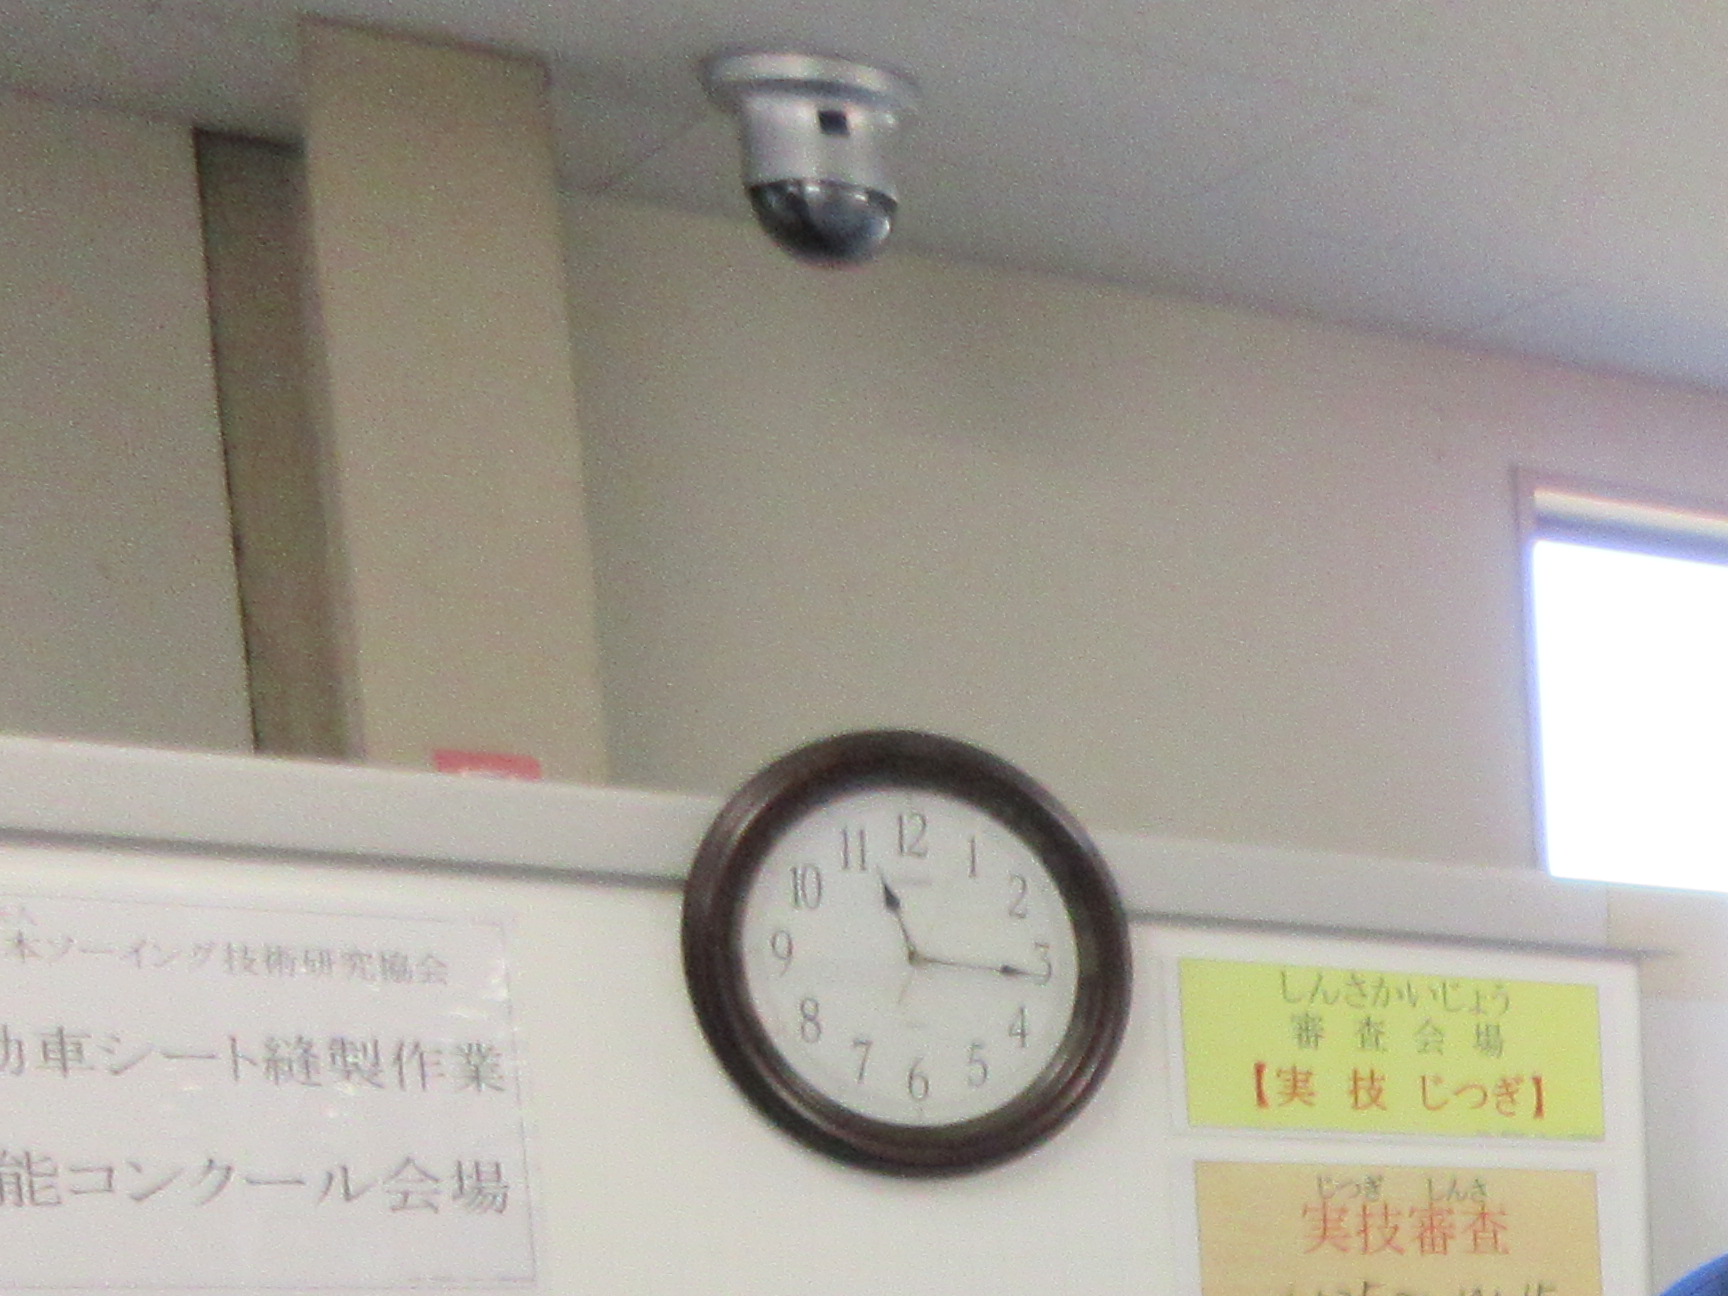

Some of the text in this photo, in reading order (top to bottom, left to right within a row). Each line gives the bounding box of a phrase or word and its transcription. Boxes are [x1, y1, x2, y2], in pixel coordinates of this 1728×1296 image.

[840, 825, 868, 872] 11
[897, 812, 929, 859] 12
[968, 834, 977, 879] 1
[789, 863, 824, 911] 10
[1008, 873, 1029, 920] 2
[770, 928, 794, 978] 9
[1032, 942, 1053, 985] 3
[800, 997, 822, 1043] 8
[1008, 1006, 1029, 1049] 4
[852, 1037, 874, 1085] 7
[908, 1056, 930, 1101] 6
[966, 1042, 989, 1087] 5
[1302, 1198, 1511, 1256] 実技審査
